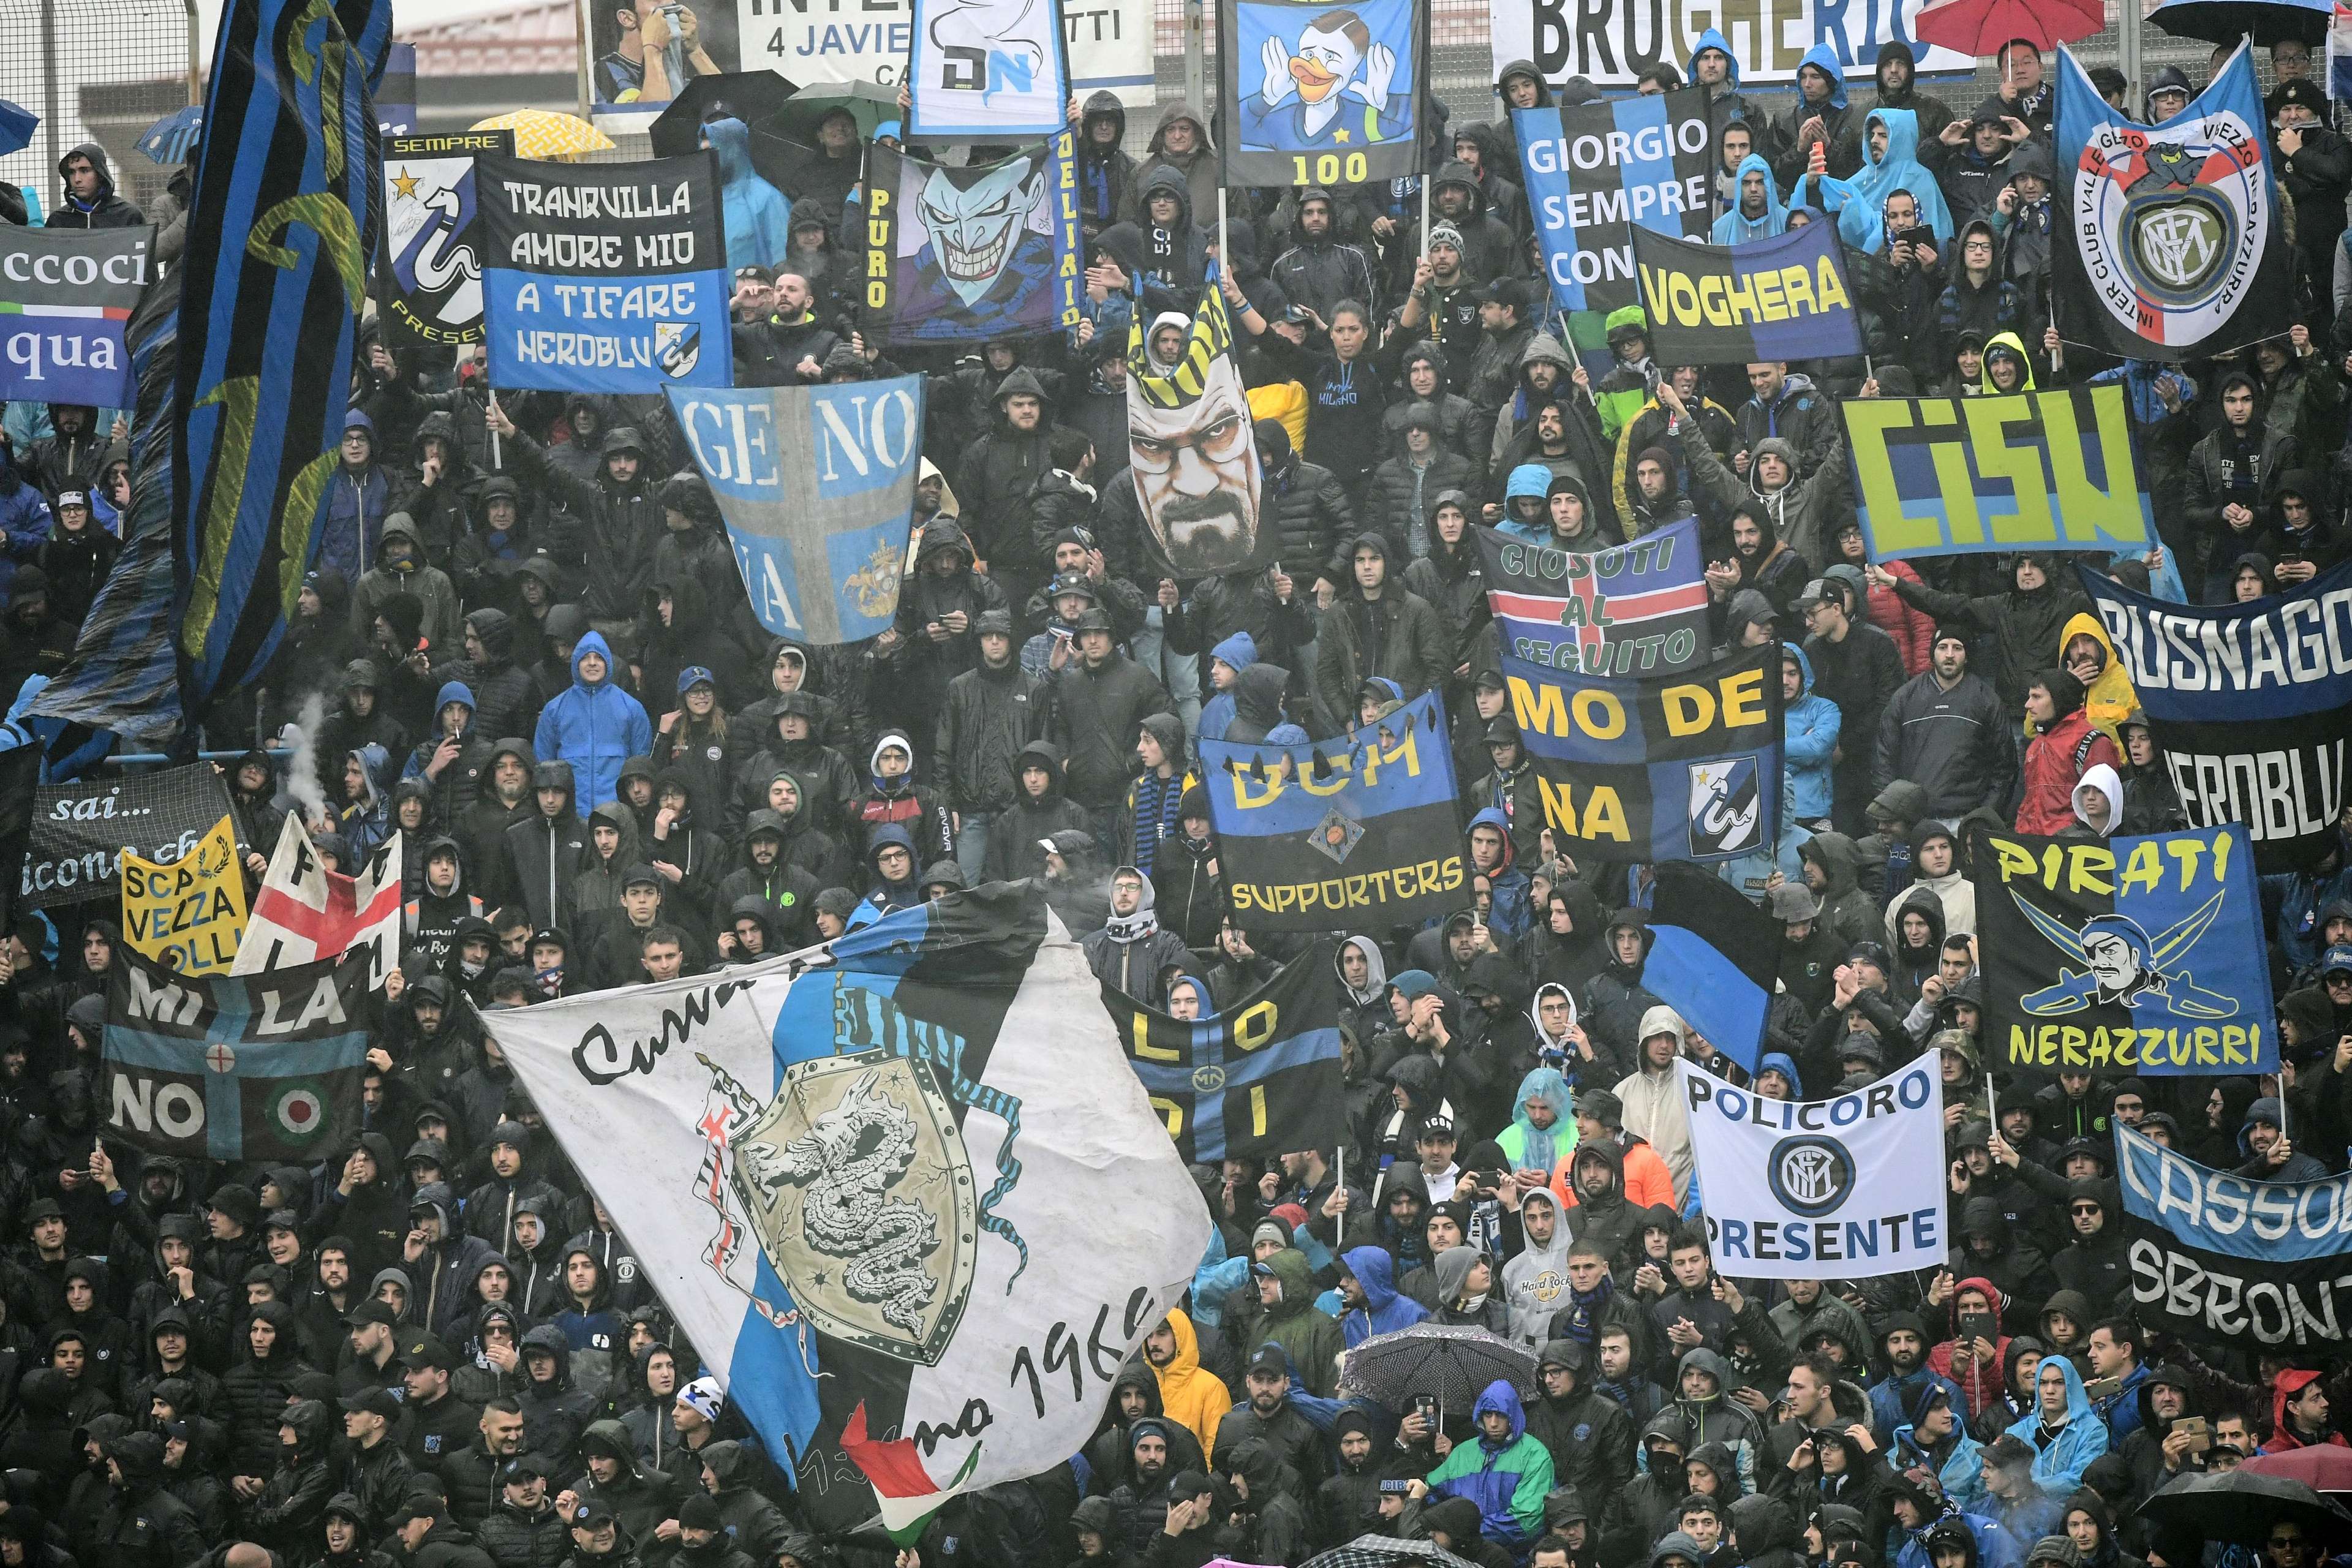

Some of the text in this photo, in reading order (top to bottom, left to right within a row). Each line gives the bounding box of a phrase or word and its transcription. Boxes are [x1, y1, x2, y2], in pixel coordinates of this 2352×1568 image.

[767, 27, 785, 57] 4
[394, 135, 499, 153] SEMPRE
[1528, 118, 1708, 174] GIORGIO
[1292, 152, 1367, 186] 100
[1543, 175, 1707, 230] SEMPRE
[3, 242, 148, 286] ccoci
[511, 231, 695, 268] AMORE MIO
[867, 188, 889, 309] PURO
[1551, 246, 1635, 286] CON
[2084, 222, 2109, 279] CLUB
[516, 282, 695, 319] A TIFARE
[1638, 255, 1852, 327] VOGHERA
[2106, 281, 2154, 329] INTER
[7, 331, 118, 380] qua
[682, 389, 916, 486] GE NO
[1501, 537, 1675, 579] CIOSOTI
[1560, 594, 1614, 627] AL
[1514, 628, 1695, 676] SEGUITO
[1506, 668, 1768, 739] MO DE
[938, 806, 951, 852] GIVOVA
[1537, 773, 1630, 843] NA
[1231, 856, 1464, 913] SUPPORTERS
[1989, 831, 2233, 898] PIRATI
[127, 886, 236, 942] VEZZA
[127, 968, 346, 1035] MI LA
[1133, 1000, 1278, 1061] L O
[2008, 1023, 2260, 1068] NERAZZURRI
[109, 1073, 205, 1138] NO
[1425, 1117, 1452, 1131] ICON
[1686, 1069, 1931, 1132] POLICORO
[1521, 1273, 1572, 1294] Hard Rock
